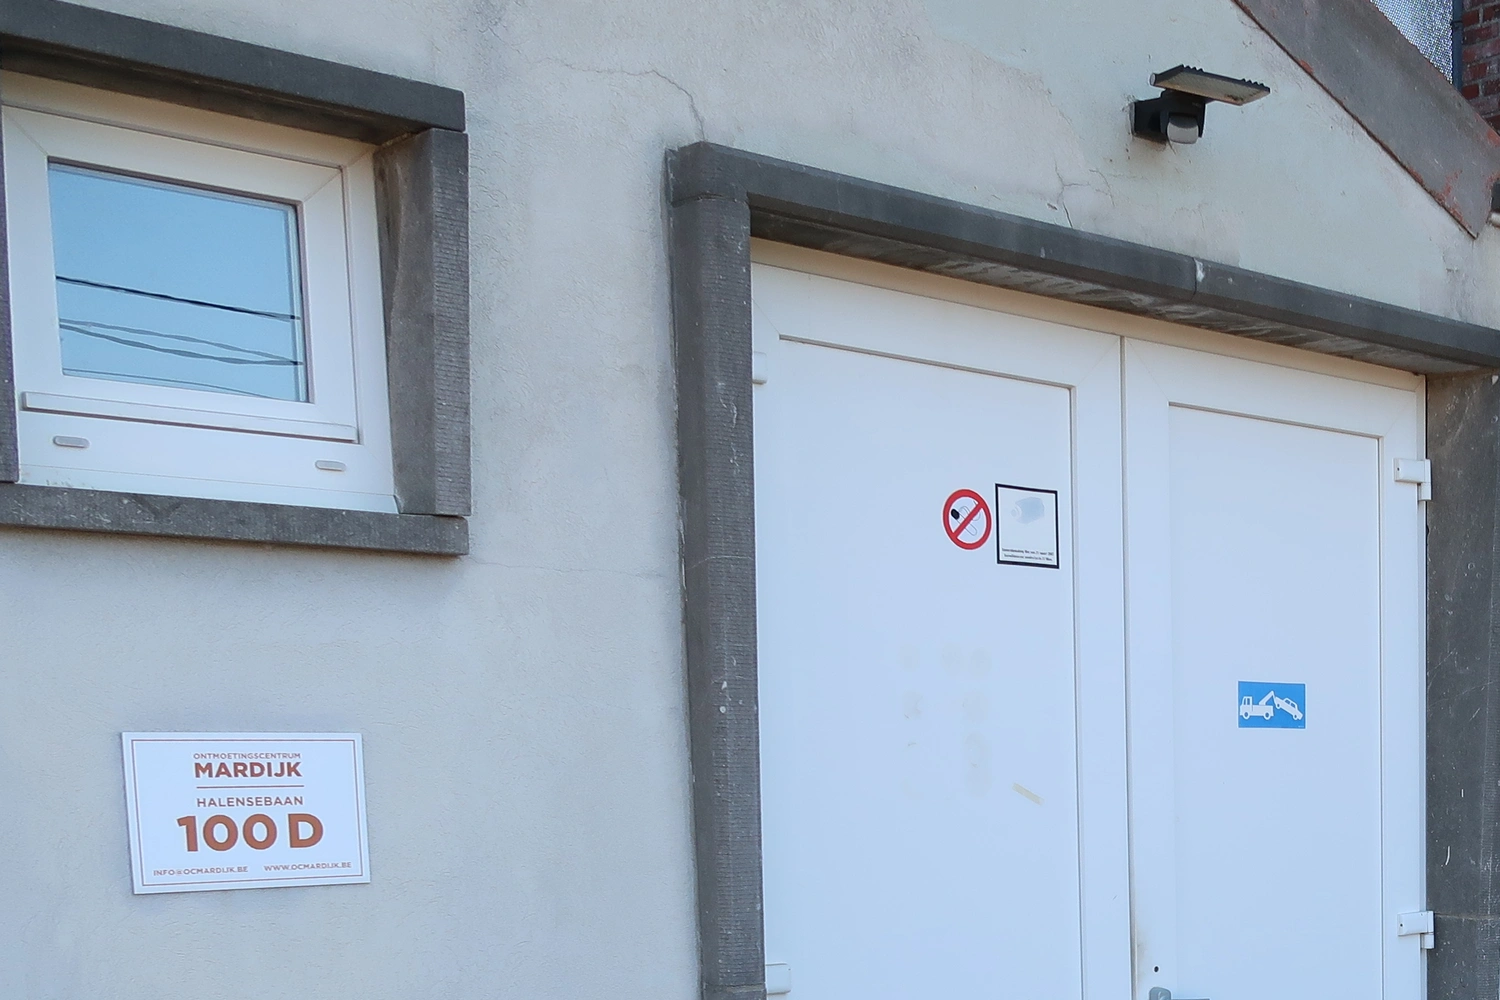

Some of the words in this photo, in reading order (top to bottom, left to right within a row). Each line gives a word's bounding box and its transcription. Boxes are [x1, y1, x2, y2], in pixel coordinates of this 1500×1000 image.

[193, 752, 302, 760] ONTMOETINGSCENTRUM
[194, 761, 303, 779] MARDIJK
[196, 795, 304, 808] HALENSEBAAN
[176, 813, 279, 852] 100
[287, 812, 324, 849] D
[263, 861, 352, 873] WWW.OCMARDIJK.BE
